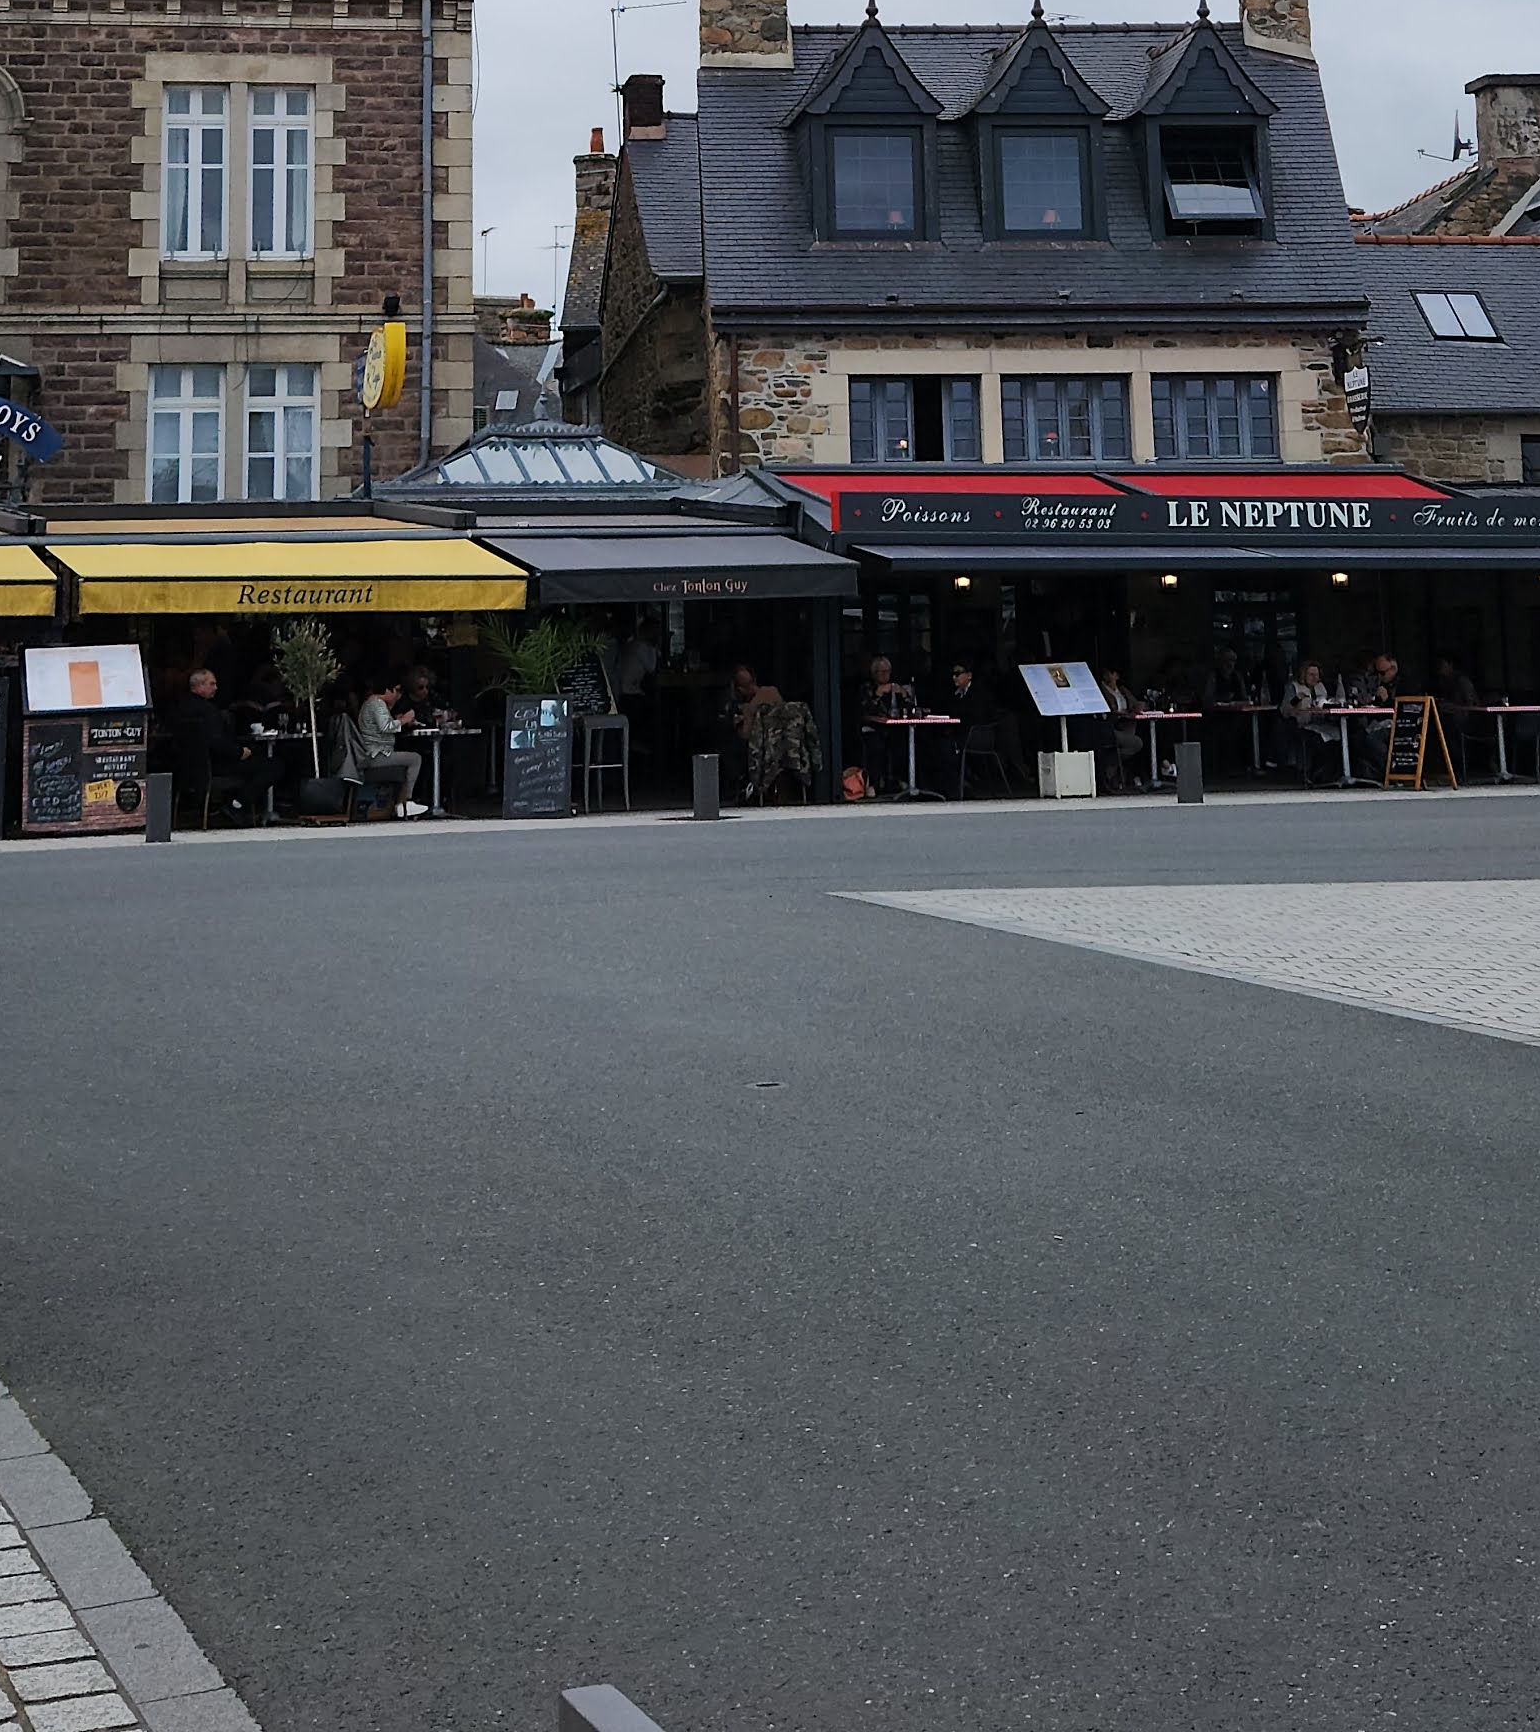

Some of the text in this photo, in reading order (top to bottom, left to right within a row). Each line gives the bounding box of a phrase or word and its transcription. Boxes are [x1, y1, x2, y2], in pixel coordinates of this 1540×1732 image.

[881, 497, 971, 524] Poissons
[1021, 496, 1117, 517] Restaurant
[1166, 501, 1371, 529] LE NEPTUNE
[1412, 504, 1479, 527] Fruits
[1485, 507, 1507, 527] de
[1024, 518, 1112, 529] 02 96 20 53 03
[237, 584, 373, 605] Restaurant
[653, 578, 748, 594] Chez Tonton Guy
